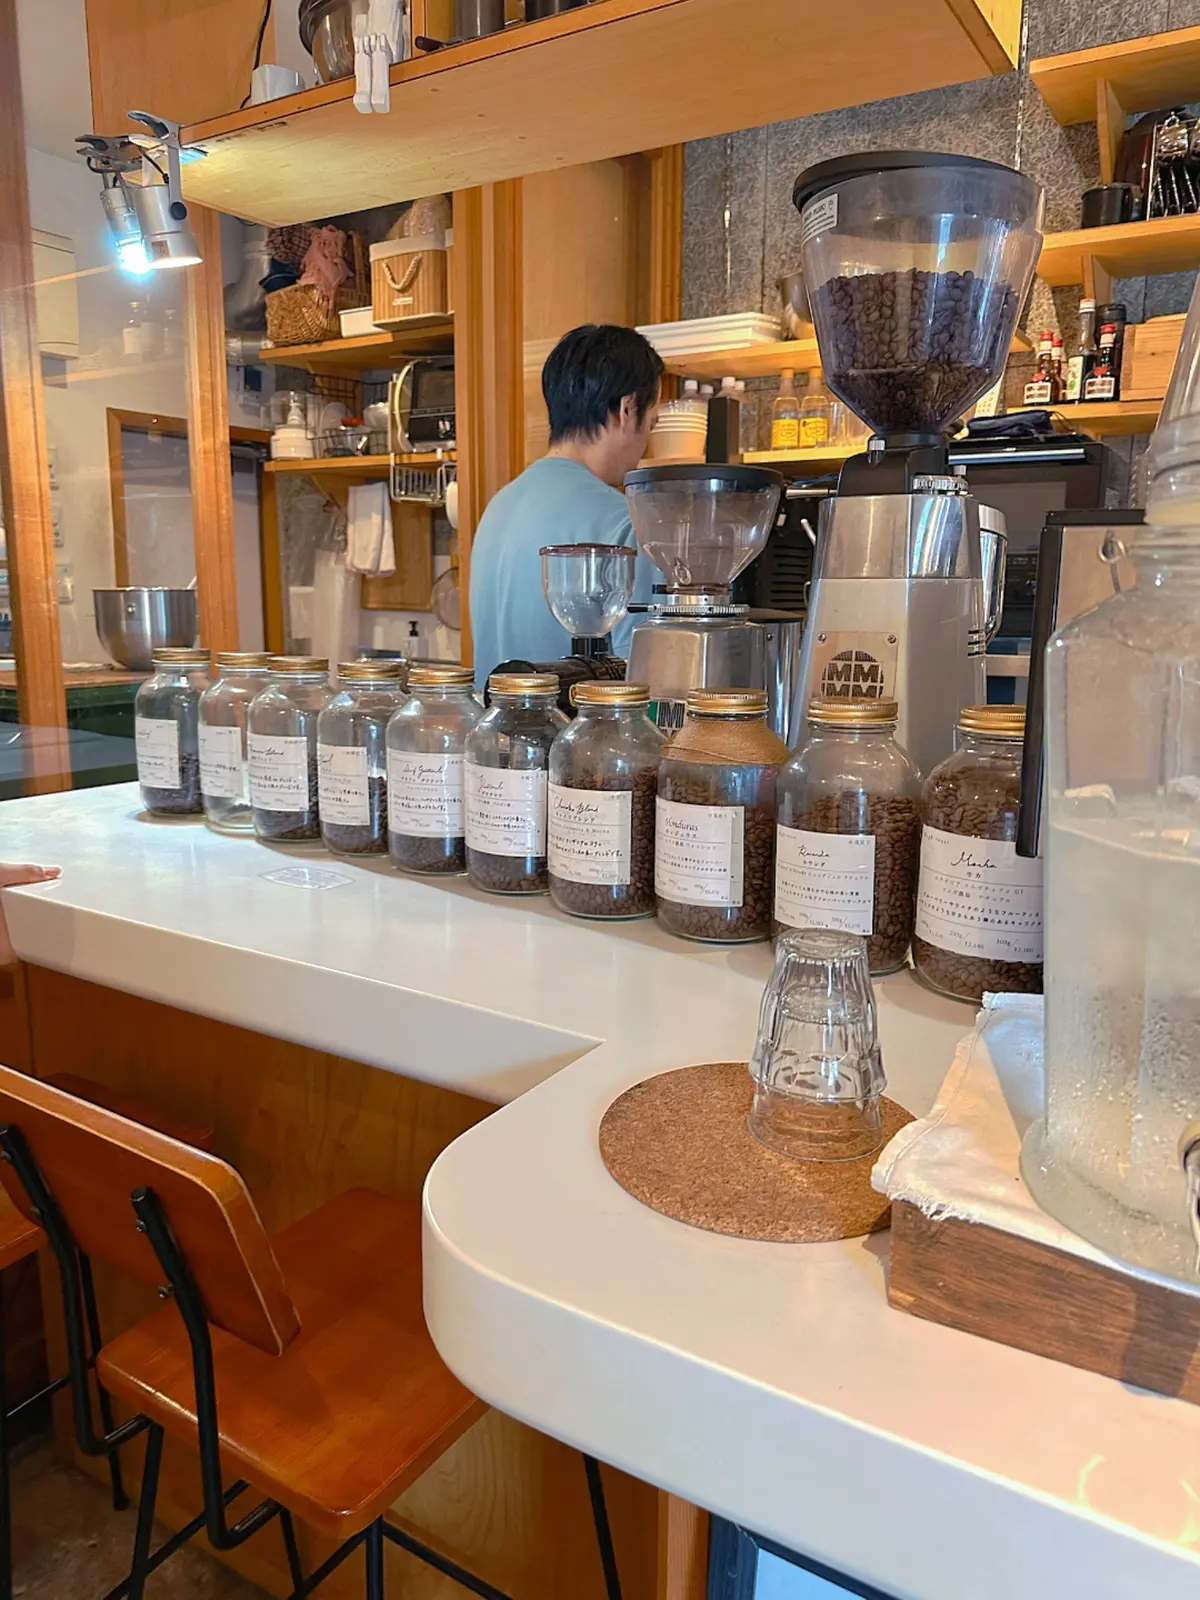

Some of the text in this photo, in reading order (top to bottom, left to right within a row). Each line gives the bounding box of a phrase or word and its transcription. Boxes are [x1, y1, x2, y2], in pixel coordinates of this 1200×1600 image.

[664, 816, 699, 831] Honduras
[950, 850, 998, 870] Mocha
[966, 871, 982, 879] モカ
